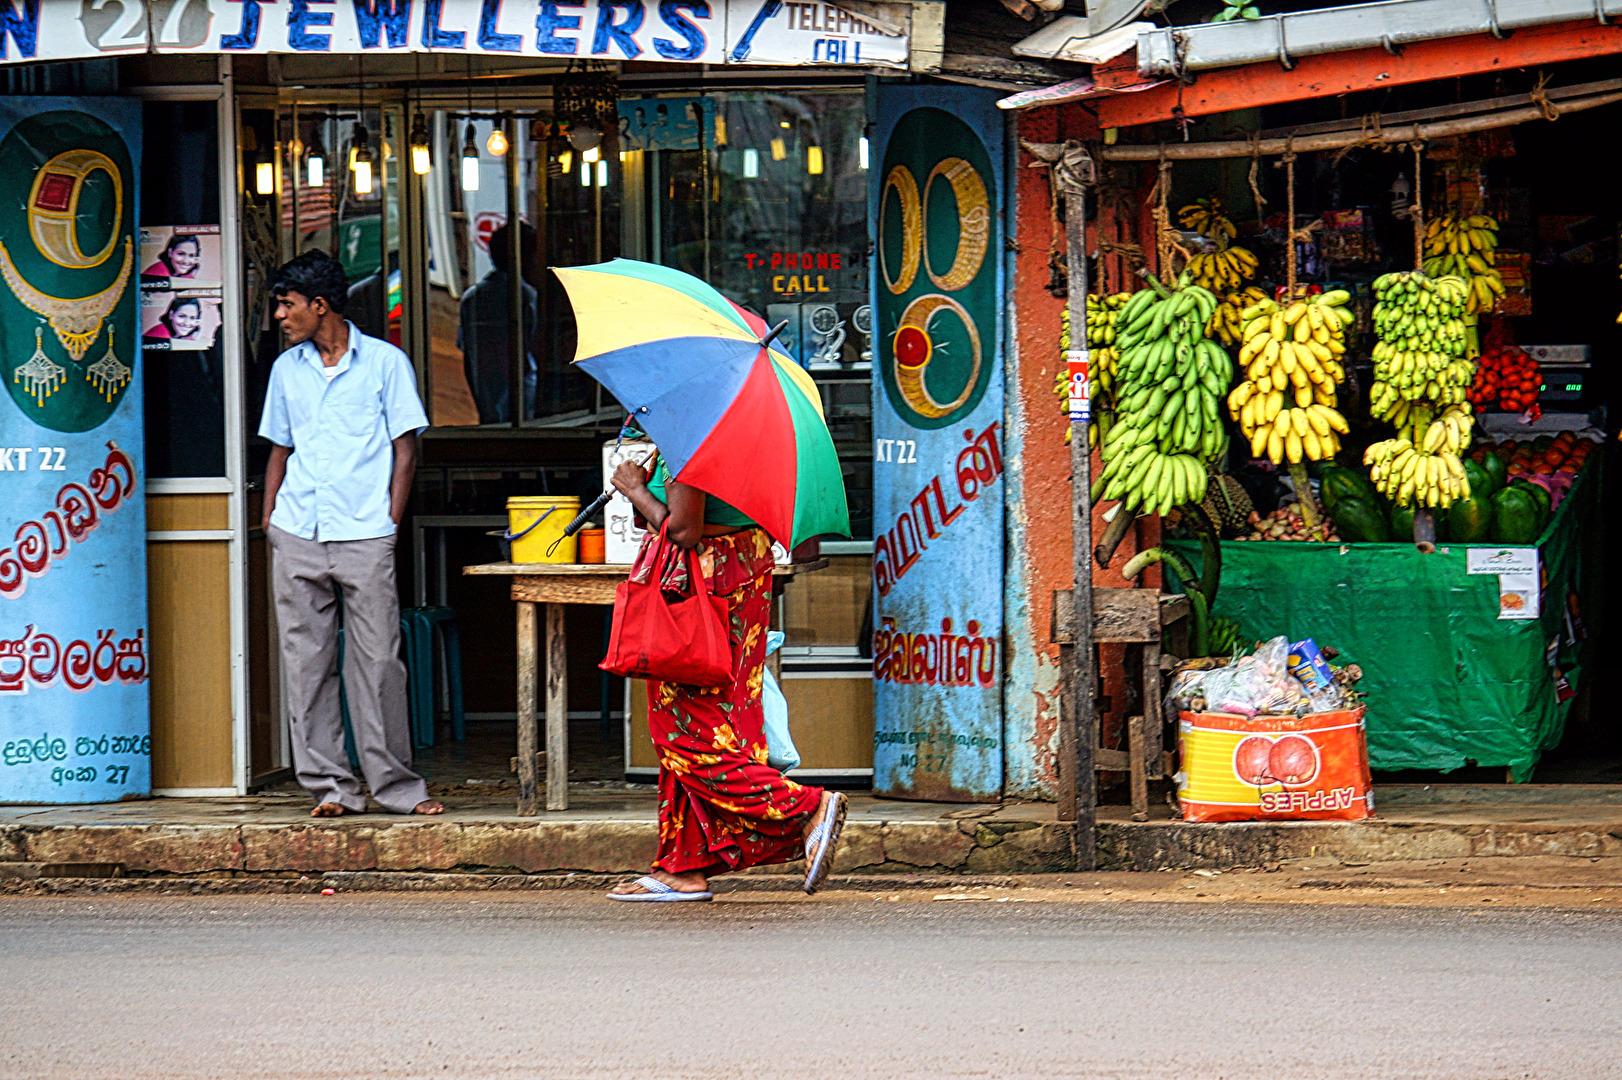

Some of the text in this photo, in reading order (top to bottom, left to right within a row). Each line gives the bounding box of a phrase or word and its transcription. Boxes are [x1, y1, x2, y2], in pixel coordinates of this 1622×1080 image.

[91, 0, 190, 47] 27
[218, 0, 713, 60] JEWLLERS
[770, 252, 842, 270] PHONE
[772, 274, 831, 292] CALL
[38, 447, 67, 471] 22
[876, 438, 917, 464] KT 22
[105, 764, 131, 785] 27
[924, 755, 948, 772] 27
[1260, 786, 1356, 813] APPLES
